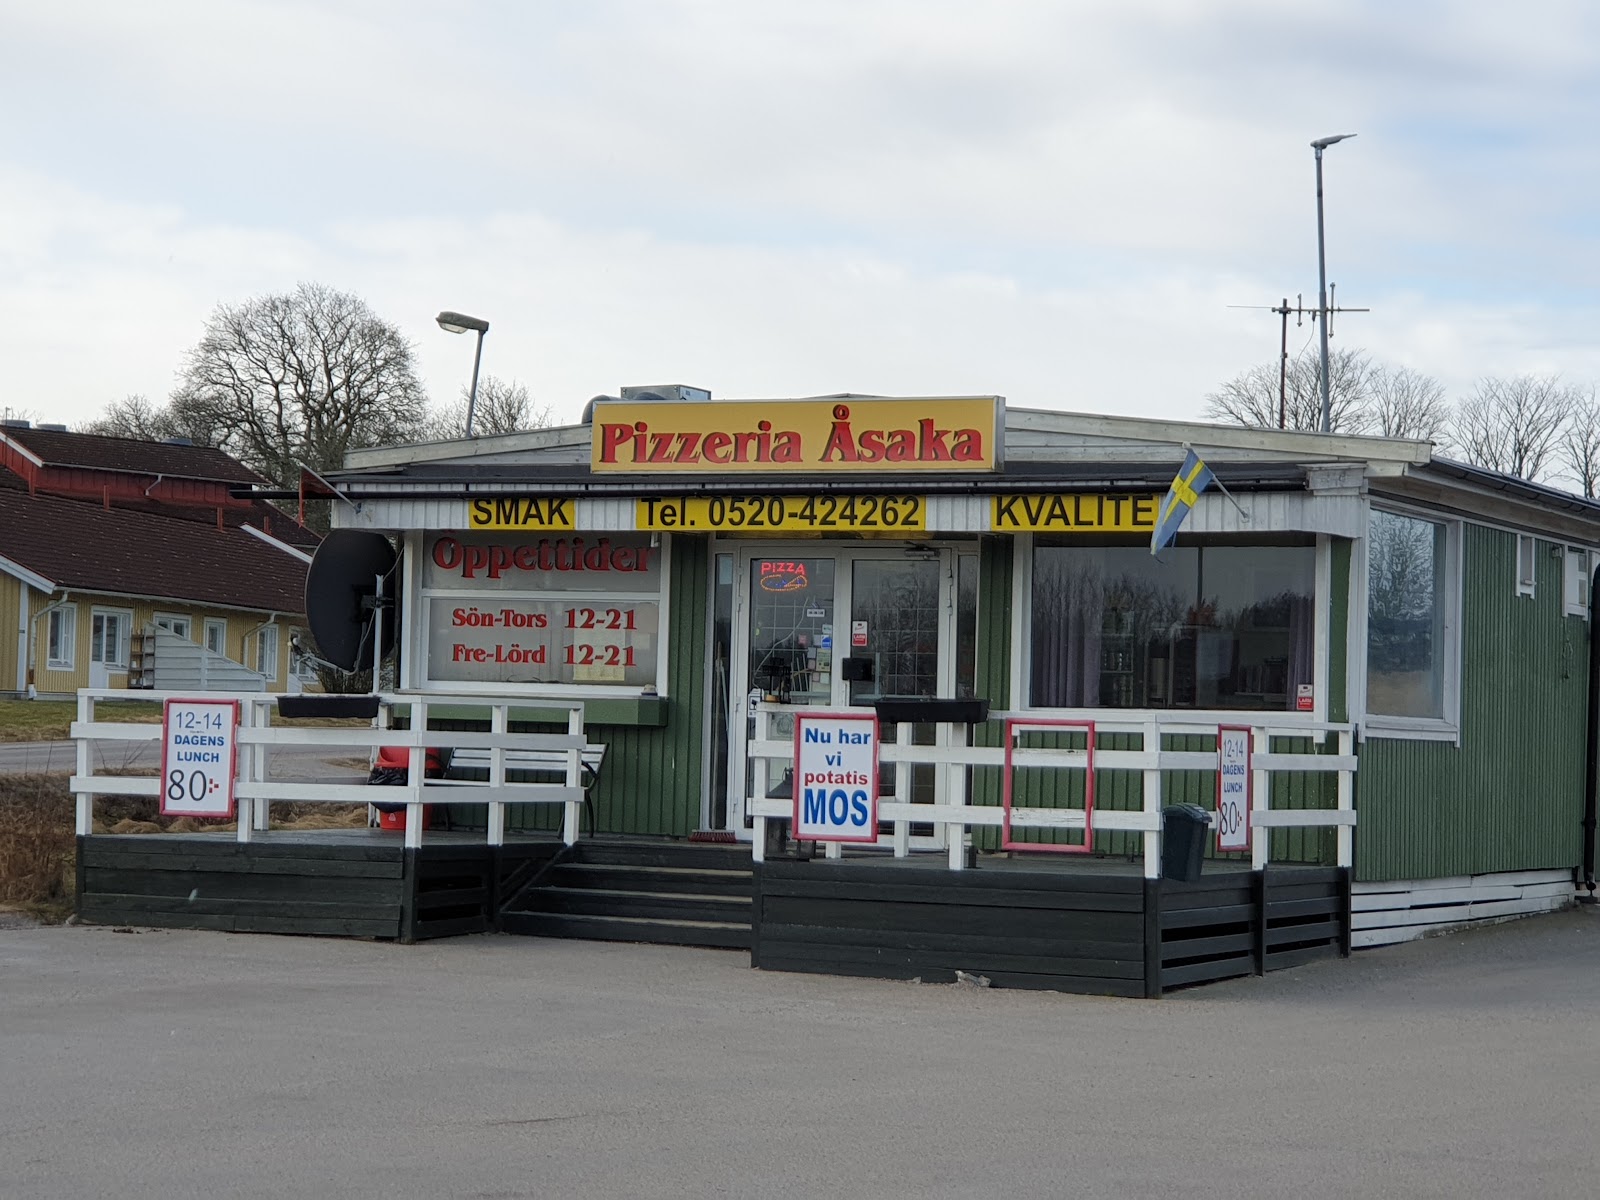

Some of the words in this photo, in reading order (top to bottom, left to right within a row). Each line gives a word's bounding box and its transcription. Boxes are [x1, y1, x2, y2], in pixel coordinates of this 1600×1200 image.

[599, 420, 803, 465] Pizzeria
[818, 404, 985, 463] Åsaka
[472, 497, 570, 526] SMAK
[641, 497, 696, 527] Tel.
[708, 496, 921, 527] 0520-424262
[995, 494, 1154, 526] KVALITE
[432, 529, 656, 579] Öppettider
[761, 562, 806, 575] PIZZA
[452, 607, 548, 629] Sön-Tors
[563, 608, 638, 630] 12-21
[452, 643, 546, 664] Fre-Lörd
[563, 644, 637, 667] 12-21
[175, 711, 222, 729] 12-14
[174, 734, 224, 746] DAGENS
[804, 727, 832, 744] Nu
[838, 728, 872, 745] har
[176, 751, 220, 763] LUNCH
[1223, 738, 1244, 758] 12-14
[824, 751, 842, 767] vi
[804, 770, 868, 786] potatis
[1222, 764, 1245, 776] DAGENS
[1223, 781, 1243, 793] LUNCH
[803, 788, 868, 827] MOS
